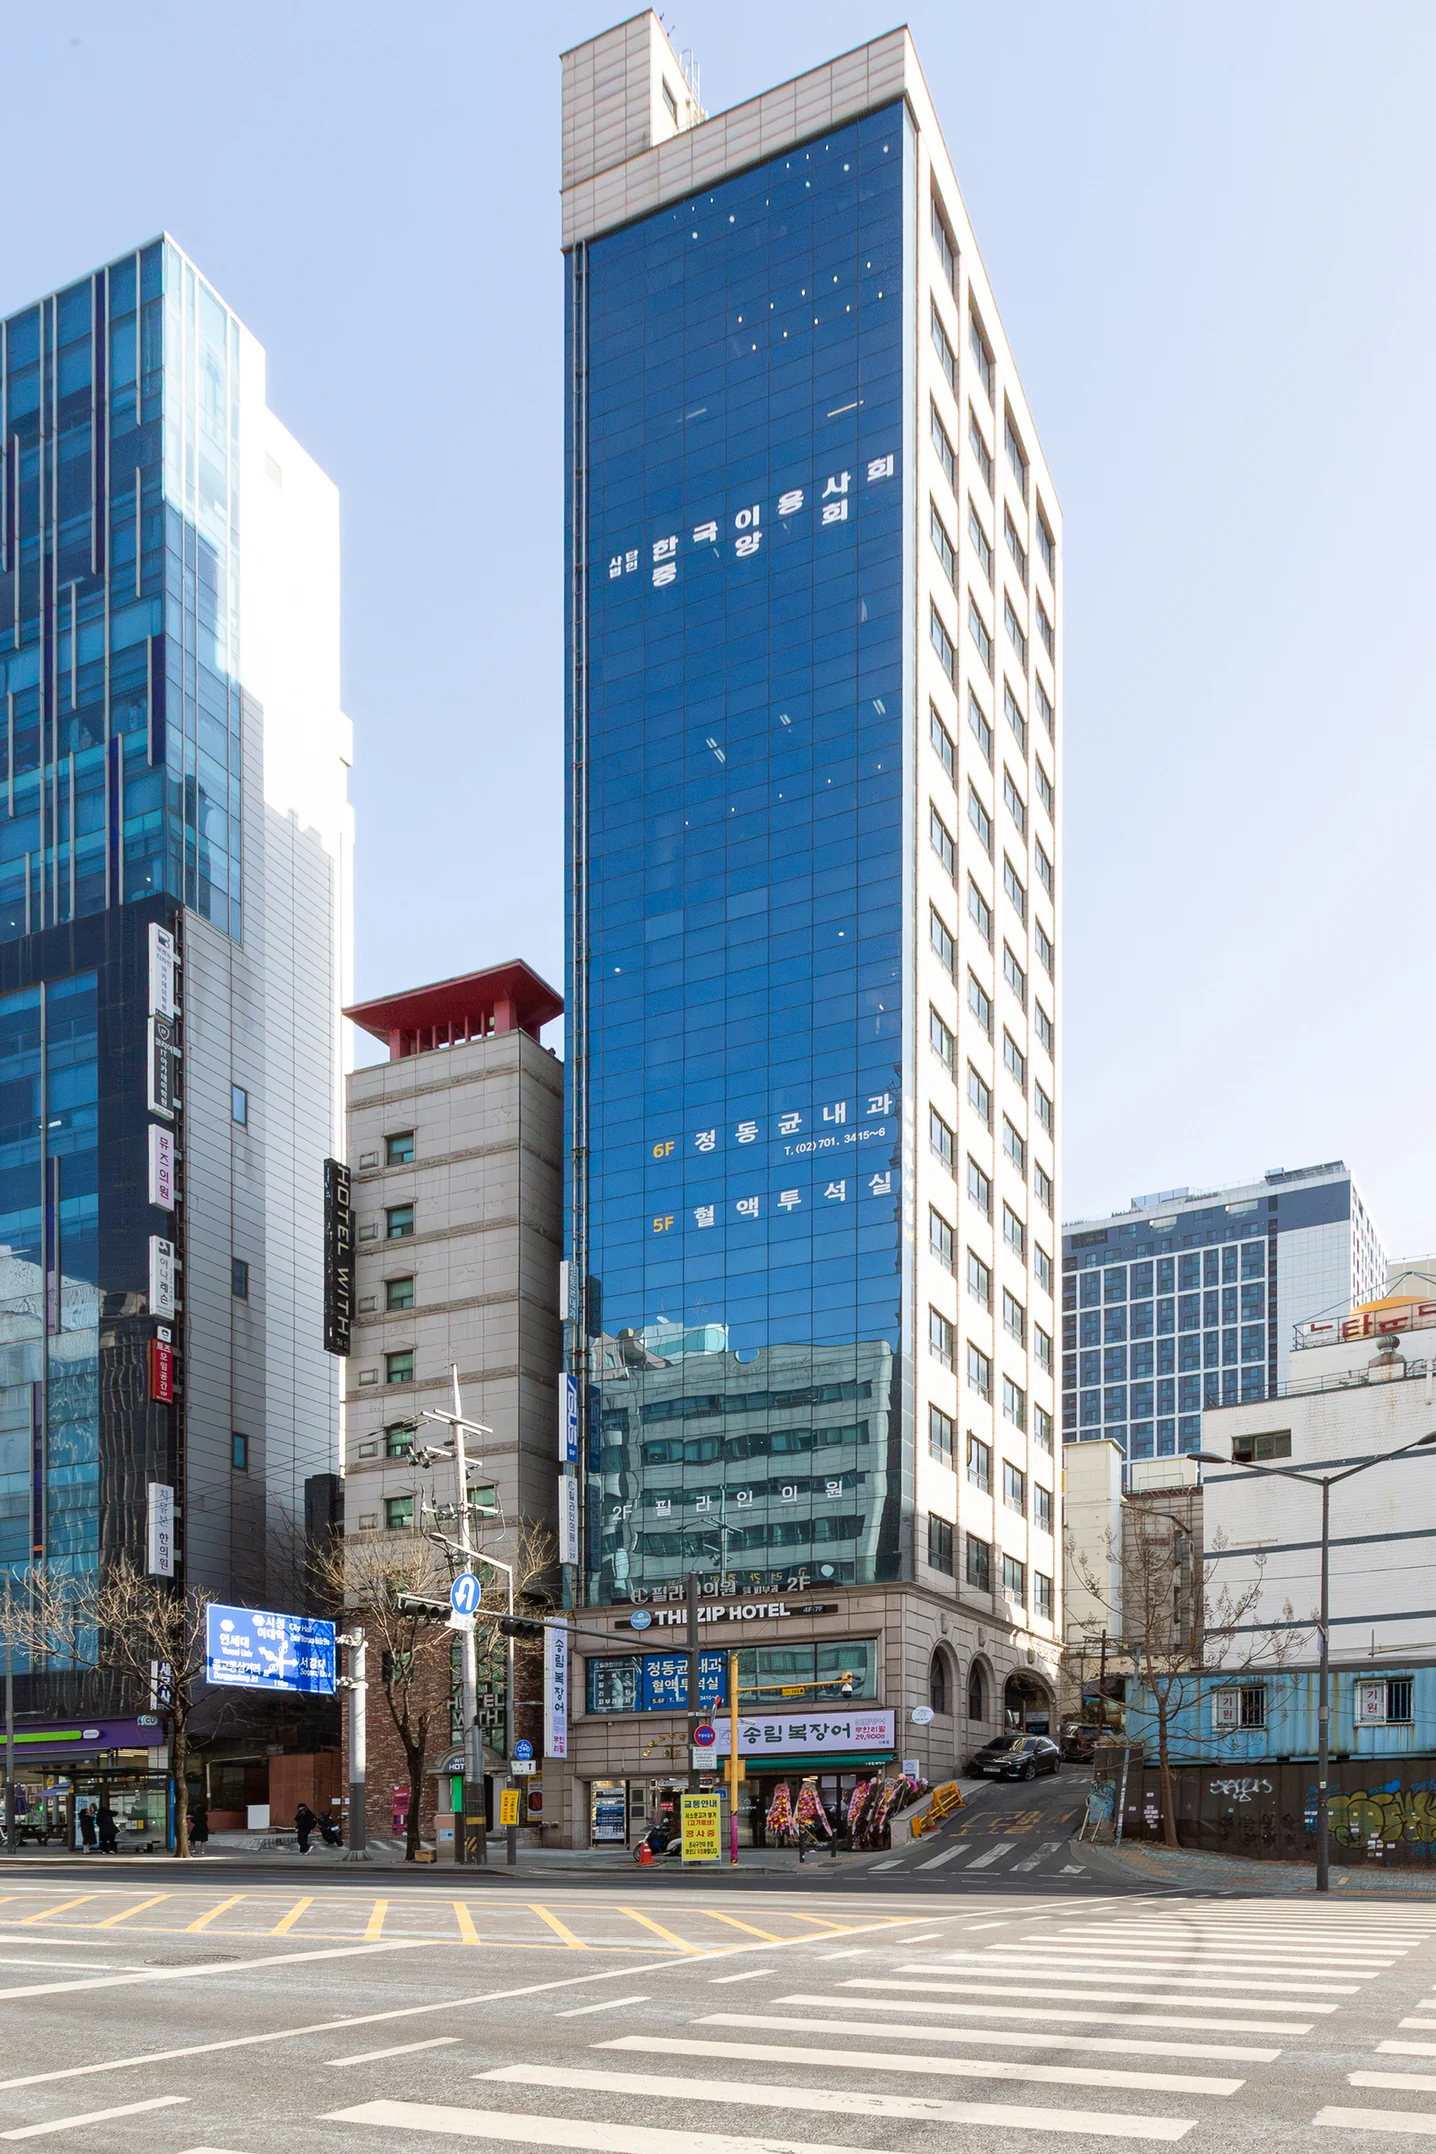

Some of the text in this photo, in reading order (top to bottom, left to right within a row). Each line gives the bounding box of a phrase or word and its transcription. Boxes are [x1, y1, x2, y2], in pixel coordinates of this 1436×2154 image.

[653, 1093, 893, 1159] 6F 정동균내과
[337, 1166, 349, 1256] HOTEL
[653, 1171, 892, 1233] 5F 혈액투석실
[337, 1266, 349, 1336] WITH
[568, 1379, 577, 1446] ASUS
[612, 1481, 842, 1521] 2F 필라인의원
[159, 1531, 169, 1571] 한의원
[788, 1576, 811, 1592] 2F
[265, 1617, 285, 1629] 시청
[729, 1602, 791, 1620] HOTEL
[300, 1657, 326, 1669] 서강대
[1222, 1697, 1233, 1720] 기원
[1367, 1690, 1378, 1713] 기원
[743, 1725, 782, 1744] 송림
[788, 1722, 851, 1742] 복장어
